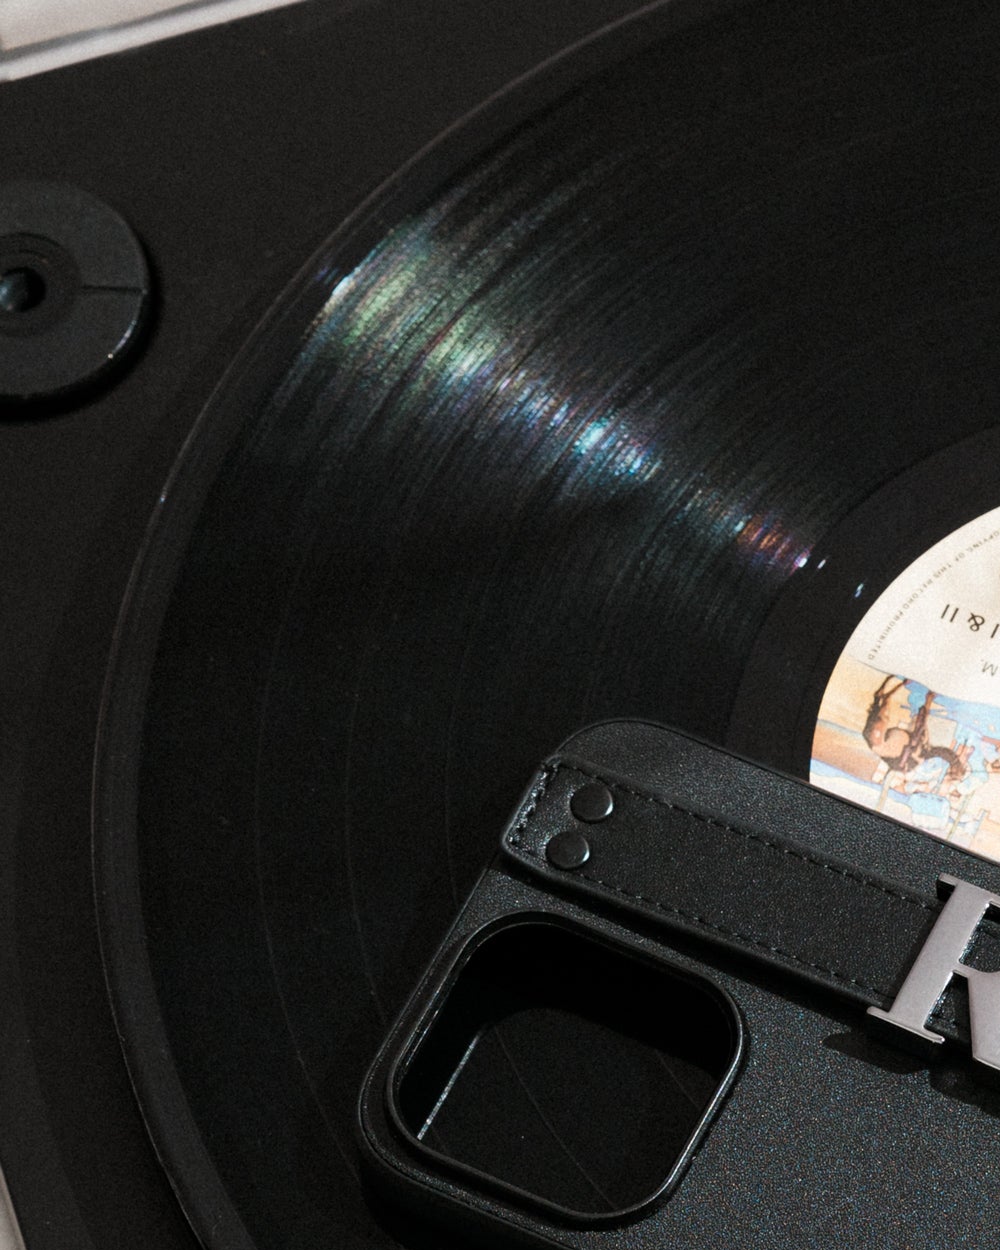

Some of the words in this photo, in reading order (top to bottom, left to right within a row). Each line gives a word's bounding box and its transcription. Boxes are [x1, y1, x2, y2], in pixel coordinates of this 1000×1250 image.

[940, 604, 959, 623] II
[967, 613, 985, 632] &
[990, 623, 1000, 639] I
